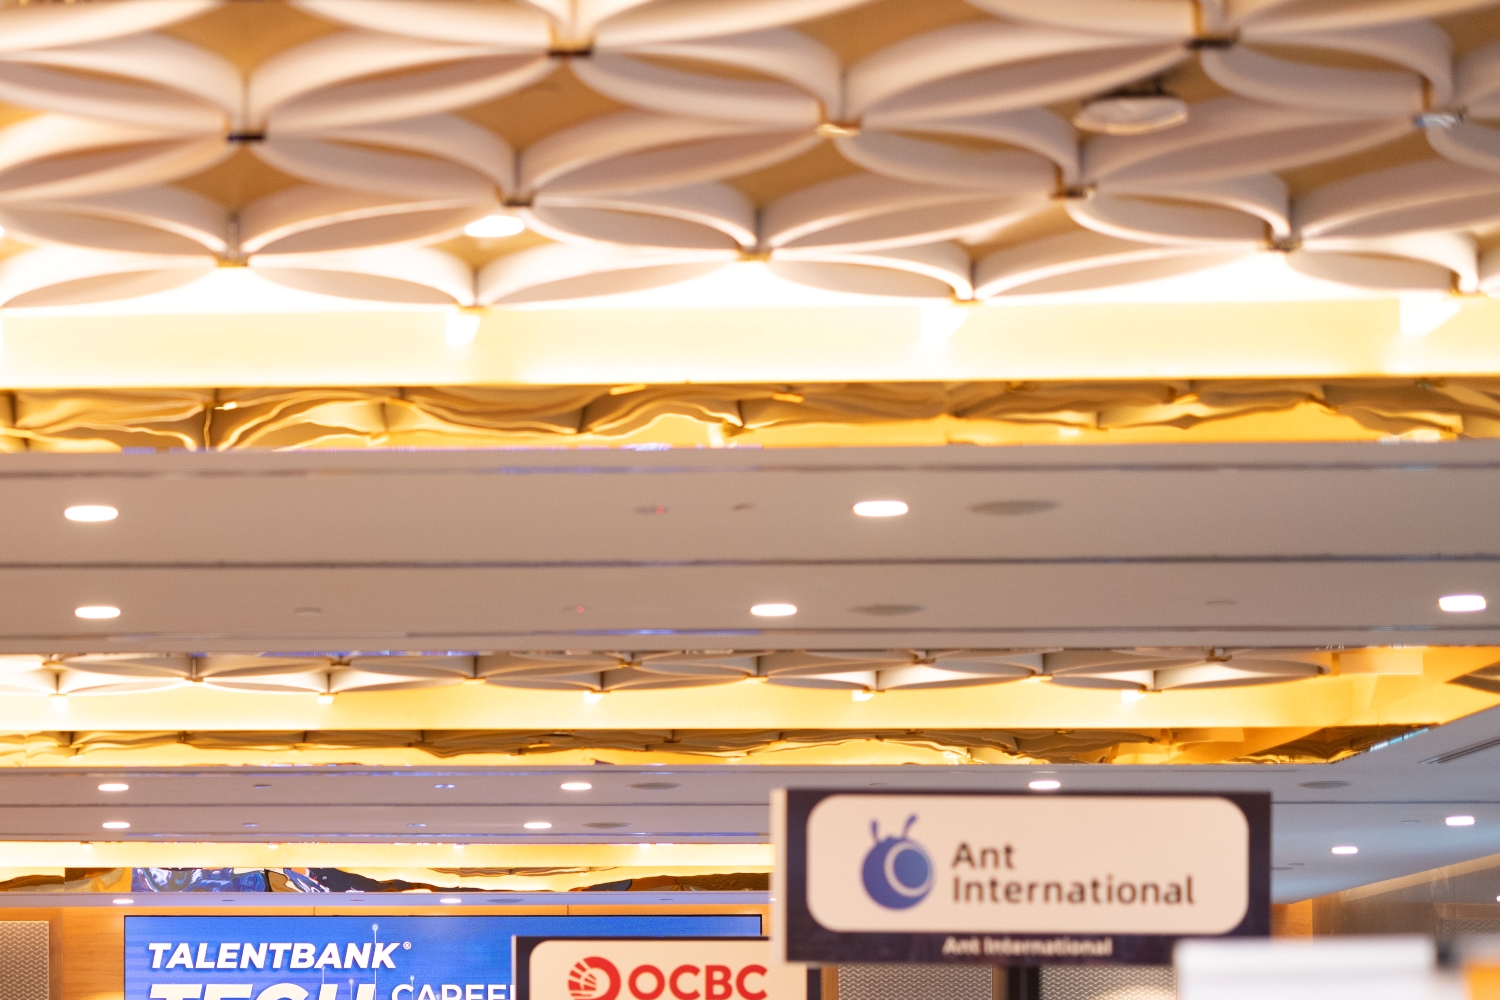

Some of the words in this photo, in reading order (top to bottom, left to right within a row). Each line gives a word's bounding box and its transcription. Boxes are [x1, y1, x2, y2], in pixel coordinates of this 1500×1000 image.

[951, 842, 1016, 870] Ant
[952, 875, 1195, 905] International
[942, 936, 979, 956] Ant
[983, 936, 1113, 957] International
